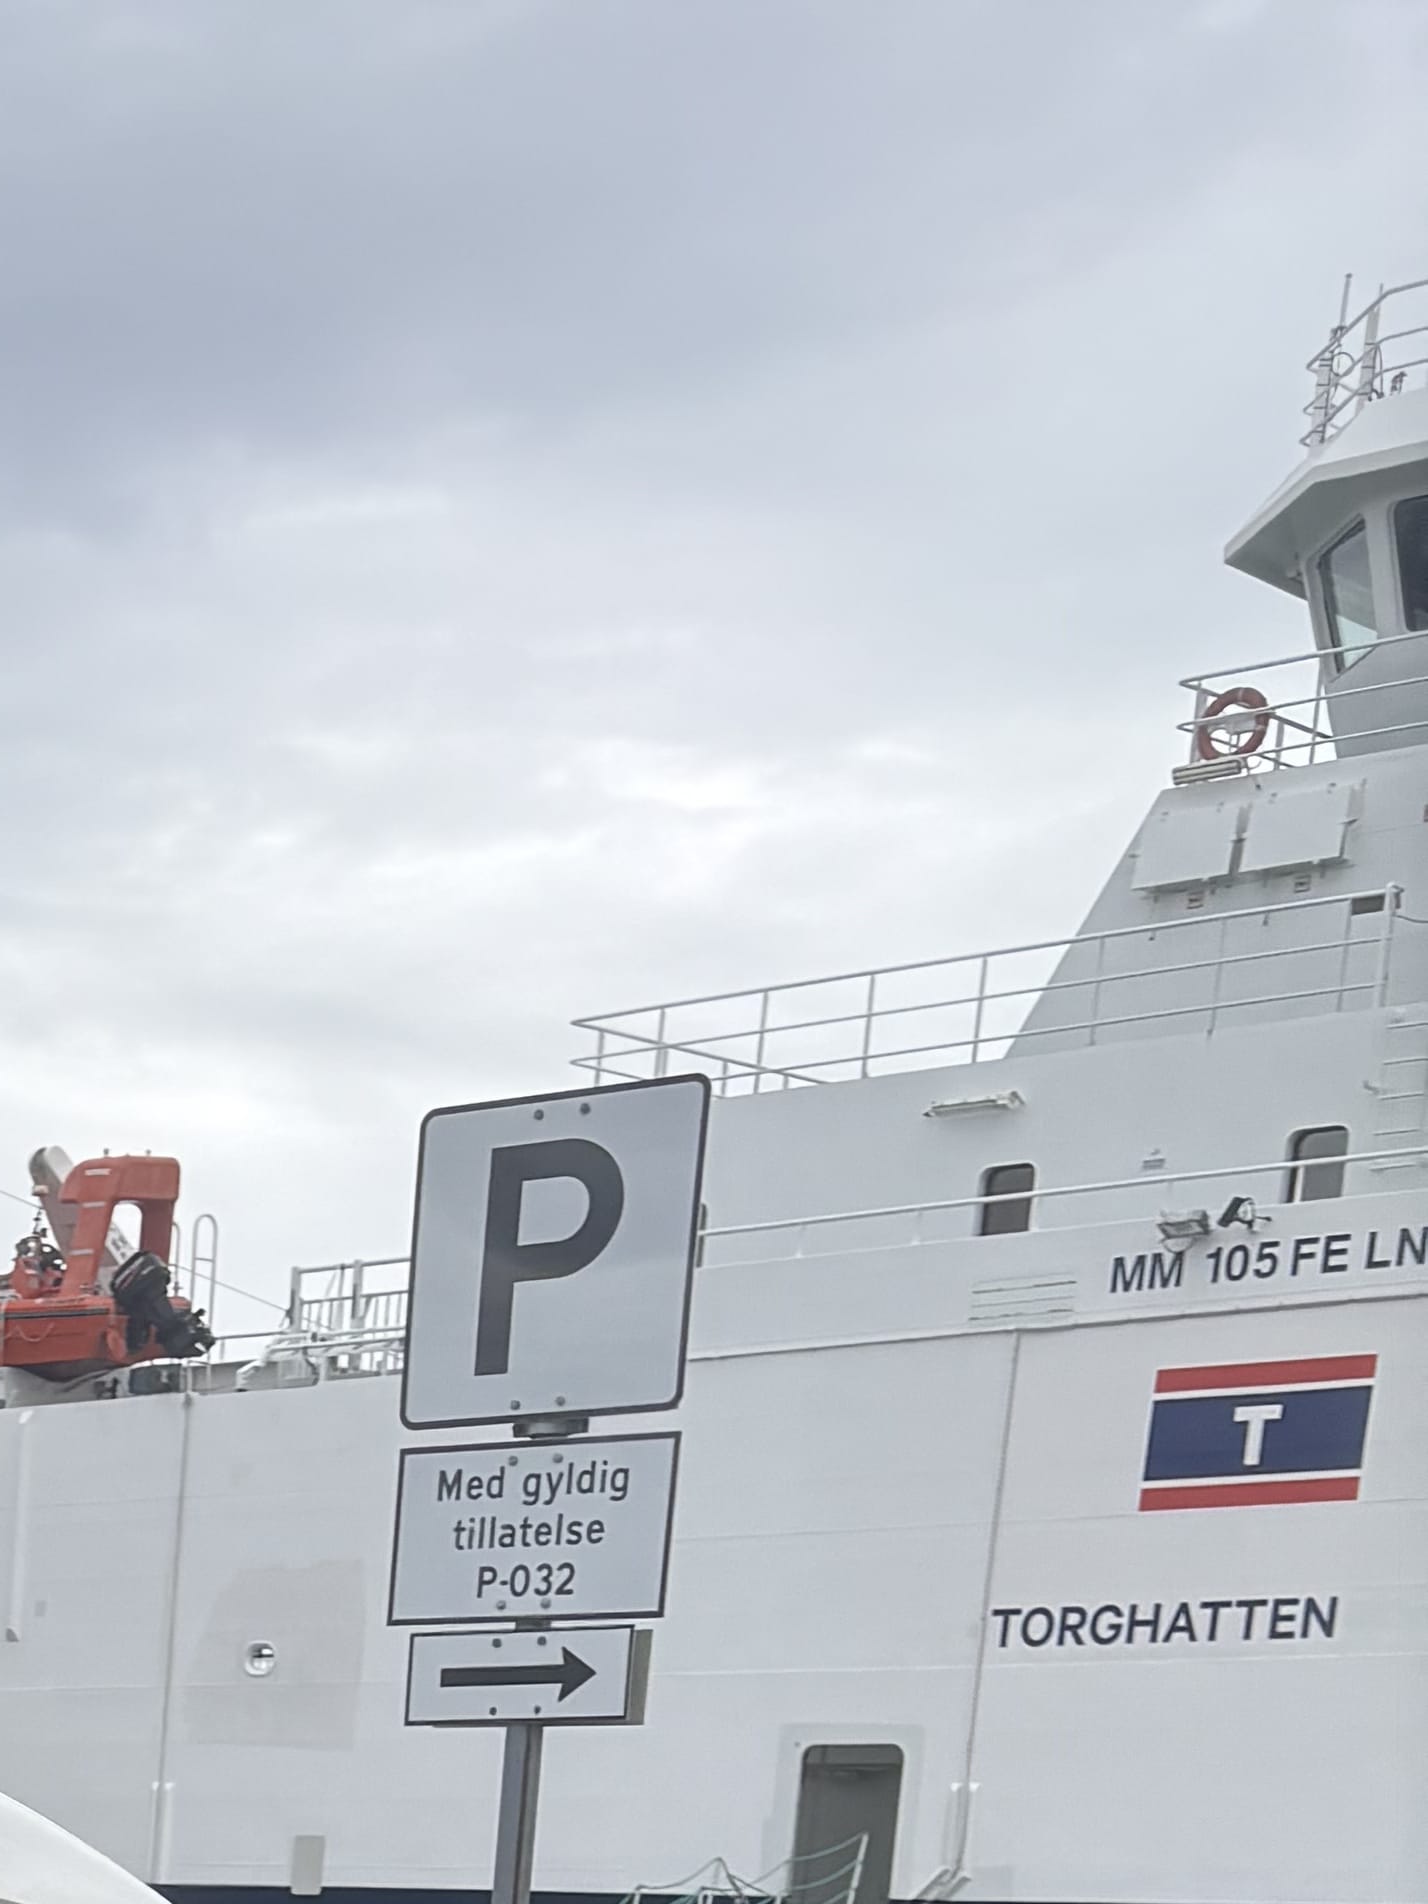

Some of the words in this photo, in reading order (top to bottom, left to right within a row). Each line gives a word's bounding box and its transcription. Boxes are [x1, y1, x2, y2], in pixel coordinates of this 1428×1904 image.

[474, 1138, 625, 1376] P
[1109, 1250, 1184, 1293] MM
[1206, 1240, 1281, 1283] 105
[1289, 1233, 1352, 1276] FE
[1233, 1403, 1285, 1466] T
[436, 1465, 506, 1501] Med
[521, 1459, 631, 1506] gyldig
[452, 1513, 606, 1550] tillatelse
[476, 1562, 576, 1599] P-032
[991, 1596, 1340, 1648] TORGHATTEN
